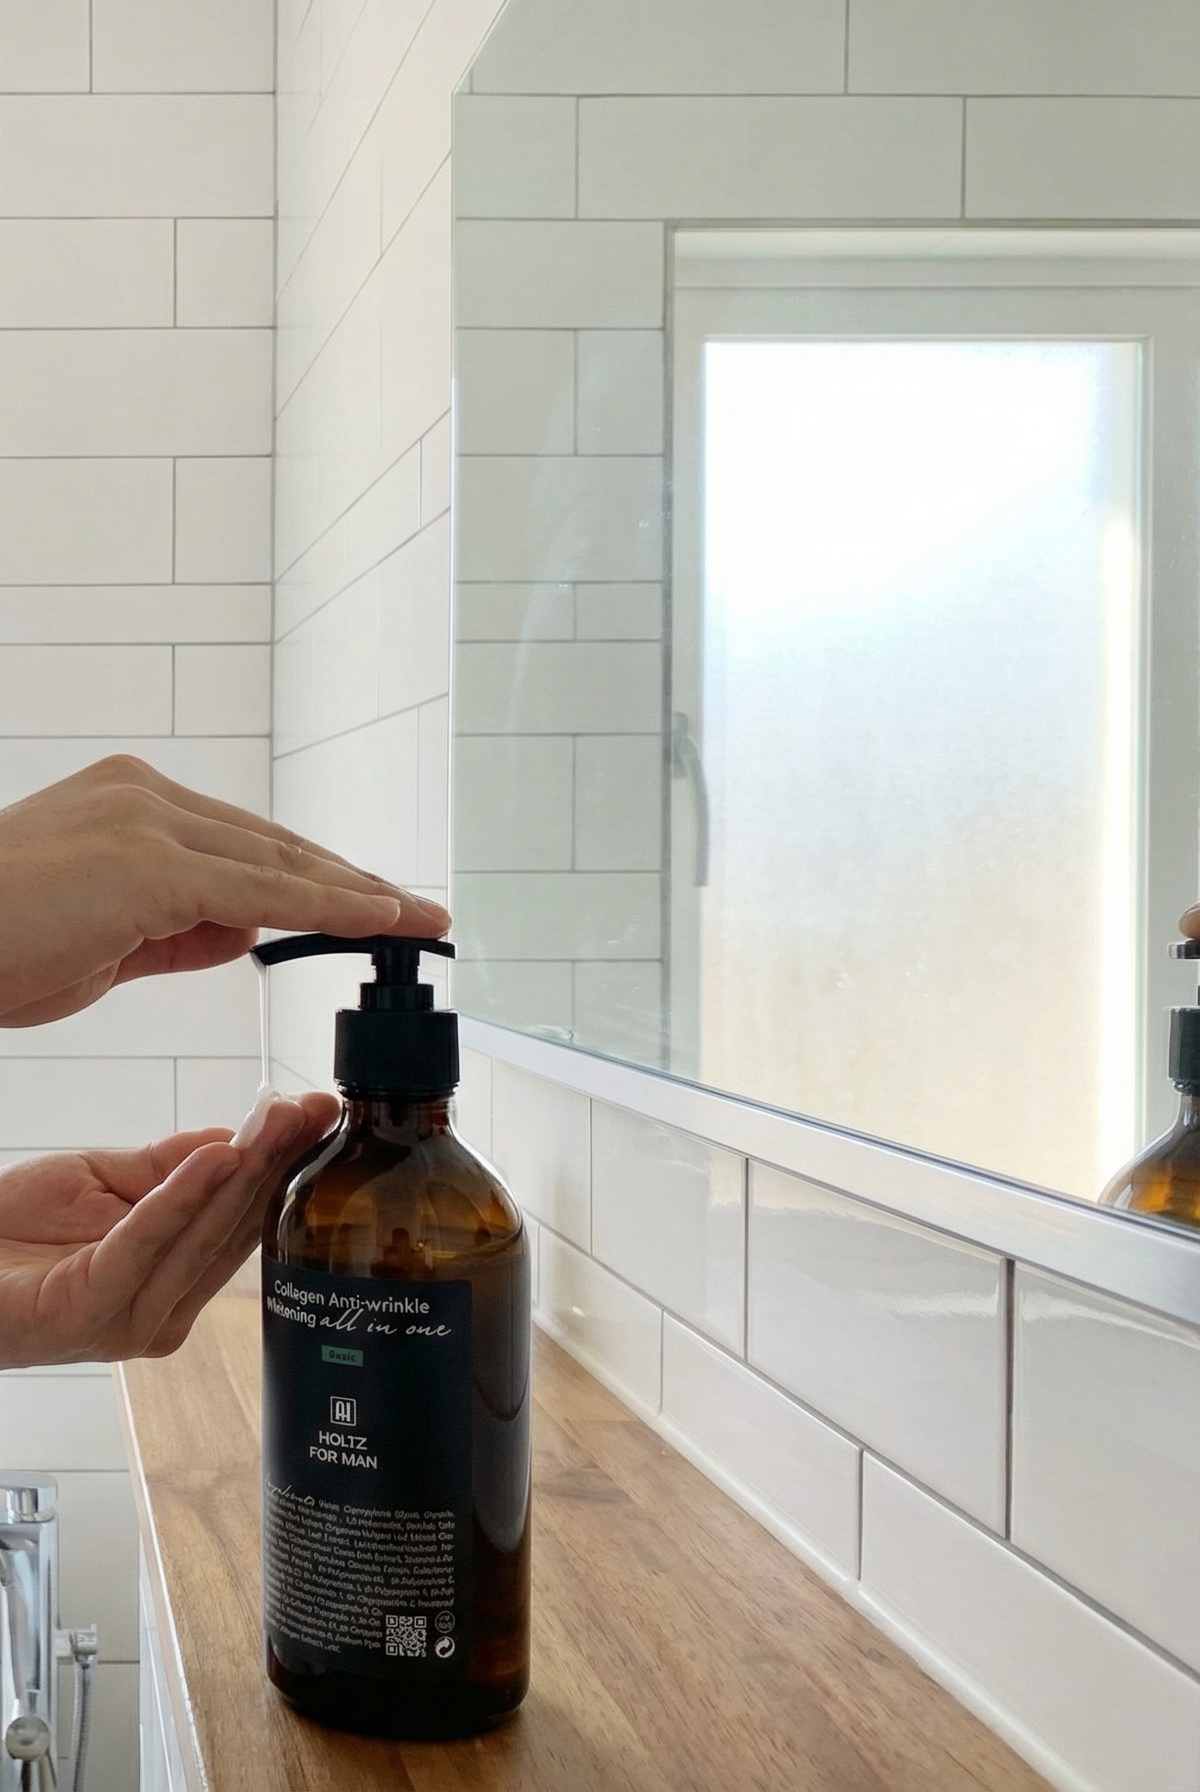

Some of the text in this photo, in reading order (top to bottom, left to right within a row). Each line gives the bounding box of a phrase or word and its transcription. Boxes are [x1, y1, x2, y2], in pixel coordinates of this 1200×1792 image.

[274, 1279, 430, 1314] Collagen Anti-wrinkle
[320, 1308, 364, 1331] all
[367, 1318, 398, 1334] in
[405, 1324, 452, 1337] one
[319, 1430, 368, 1450] HOLTZ
[309, 1446, 377, 1469] FOR MAN
